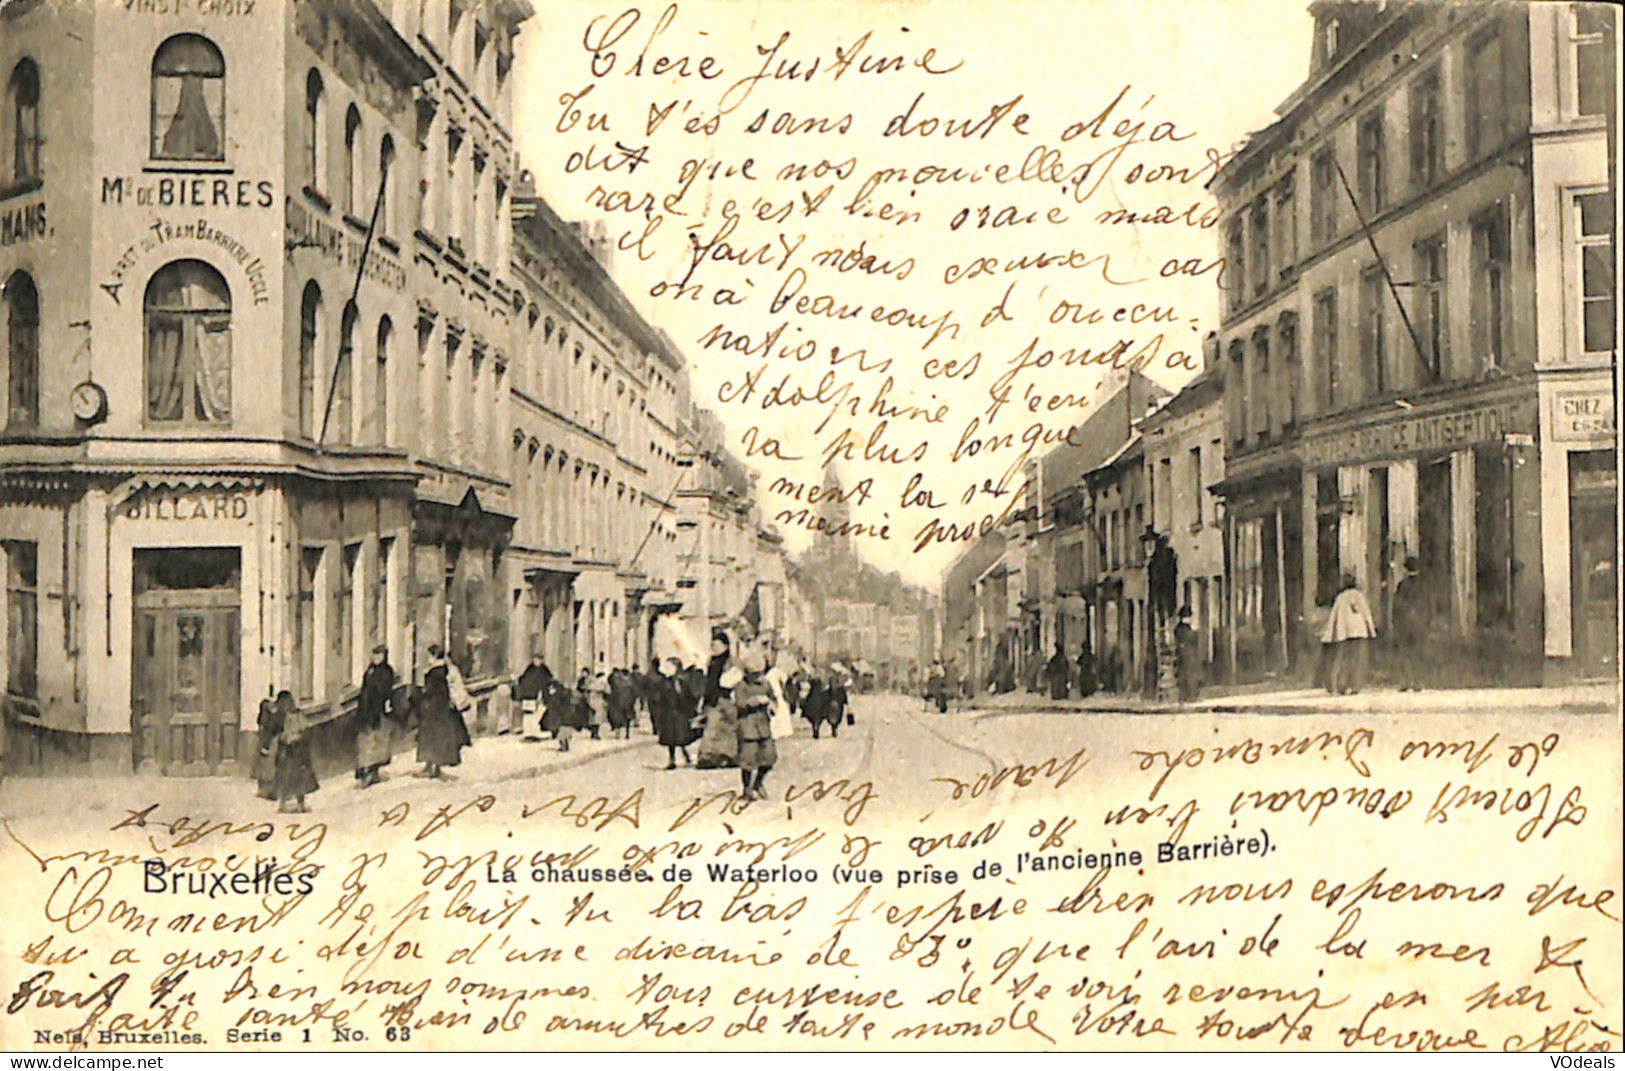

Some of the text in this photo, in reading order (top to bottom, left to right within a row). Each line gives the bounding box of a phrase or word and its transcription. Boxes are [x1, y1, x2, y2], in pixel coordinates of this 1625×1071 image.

[744, 108, 853, 135] sans
[882, 92, 1030, 138] doute
[159, 178, 273, 208] BIERES
[678, 157, 757, 201] que
[776, 157, 856, 182] nos
[770, 267, 960, 350] beaucoup
[900, 473, 947, 509] la
[144, 858, 313, 898] Bruxelles
[487, 865, 517, 883] La
[662, 863, 693, 883] de
[707, 864, 818, 883] Waterloo
[832, 864, 883, 885] (vue
[897, 864, 959, 887] prise
[972, 858, 1003, 880] de
[1017, 848, 1143, 873] l'ancienne
[1178, 878, 1293, 904] nous
[1527, 875, 1624, 921] que
[807, 930, 858, 966] de
[1321, 907, 1368, 958] la
[1400, 941, 1490, 966] mer
[99, 1030, 208, 1044] Bruxelles.
[227, 1029, 282, 1043] Serie
[301, 1029, 312, 1043] 1
[333, 1029, 370, 1043] No.
[386, 1029, 412, 1042] 63
